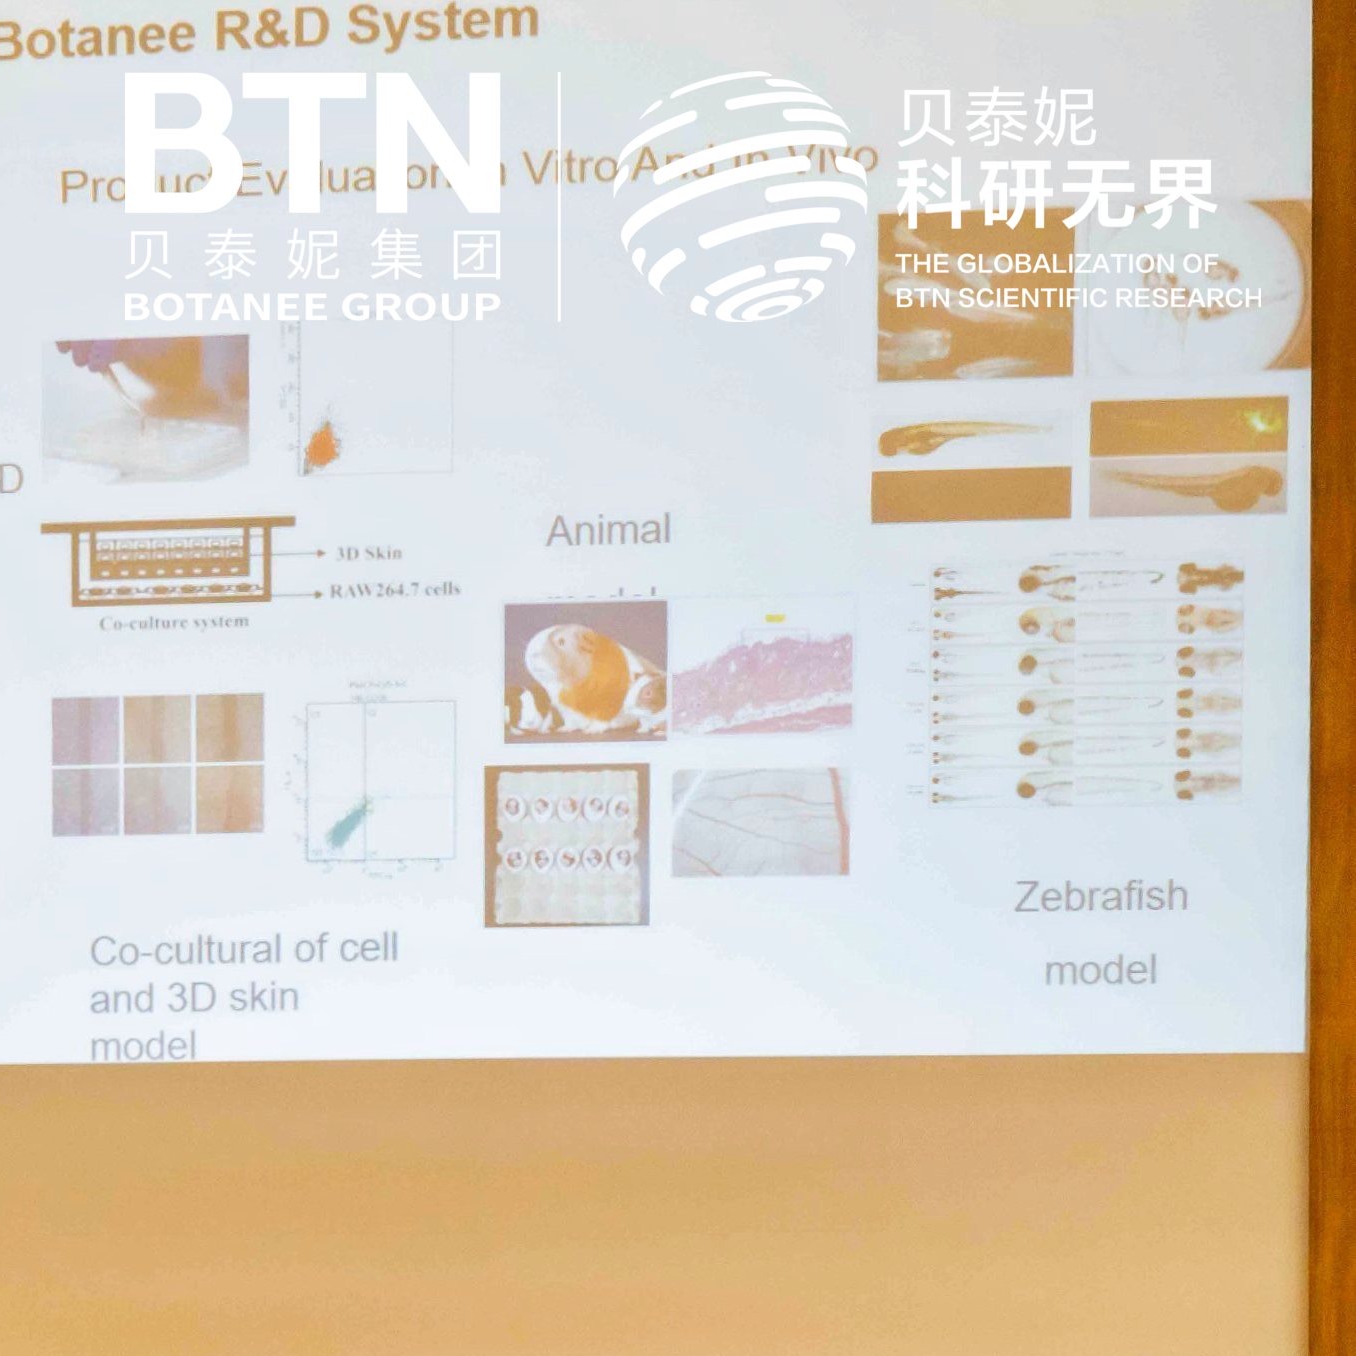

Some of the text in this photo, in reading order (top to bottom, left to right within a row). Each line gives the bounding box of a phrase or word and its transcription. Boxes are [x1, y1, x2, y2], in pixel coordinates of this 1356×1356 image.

[216, 5, 330, 52] R&D
[348, 1, 539, 55] System
[522, 149, 619, 185] Vitro
[545, 512, 671, 547] Animal
[336, 546, 403, 561] 3D Skin
[424, 581, 461, 597] cells
[98, 615, 250, 632] Co-culture system
[1015, 878, 1188, 913] Zebrafish
[90, 930, 399, 967] Co-cultural of cell
[1045, 953, 1157, 986] model
[90, 980, 299, 1015] and 3D skin
[91, 1029, 196, 1062] model
